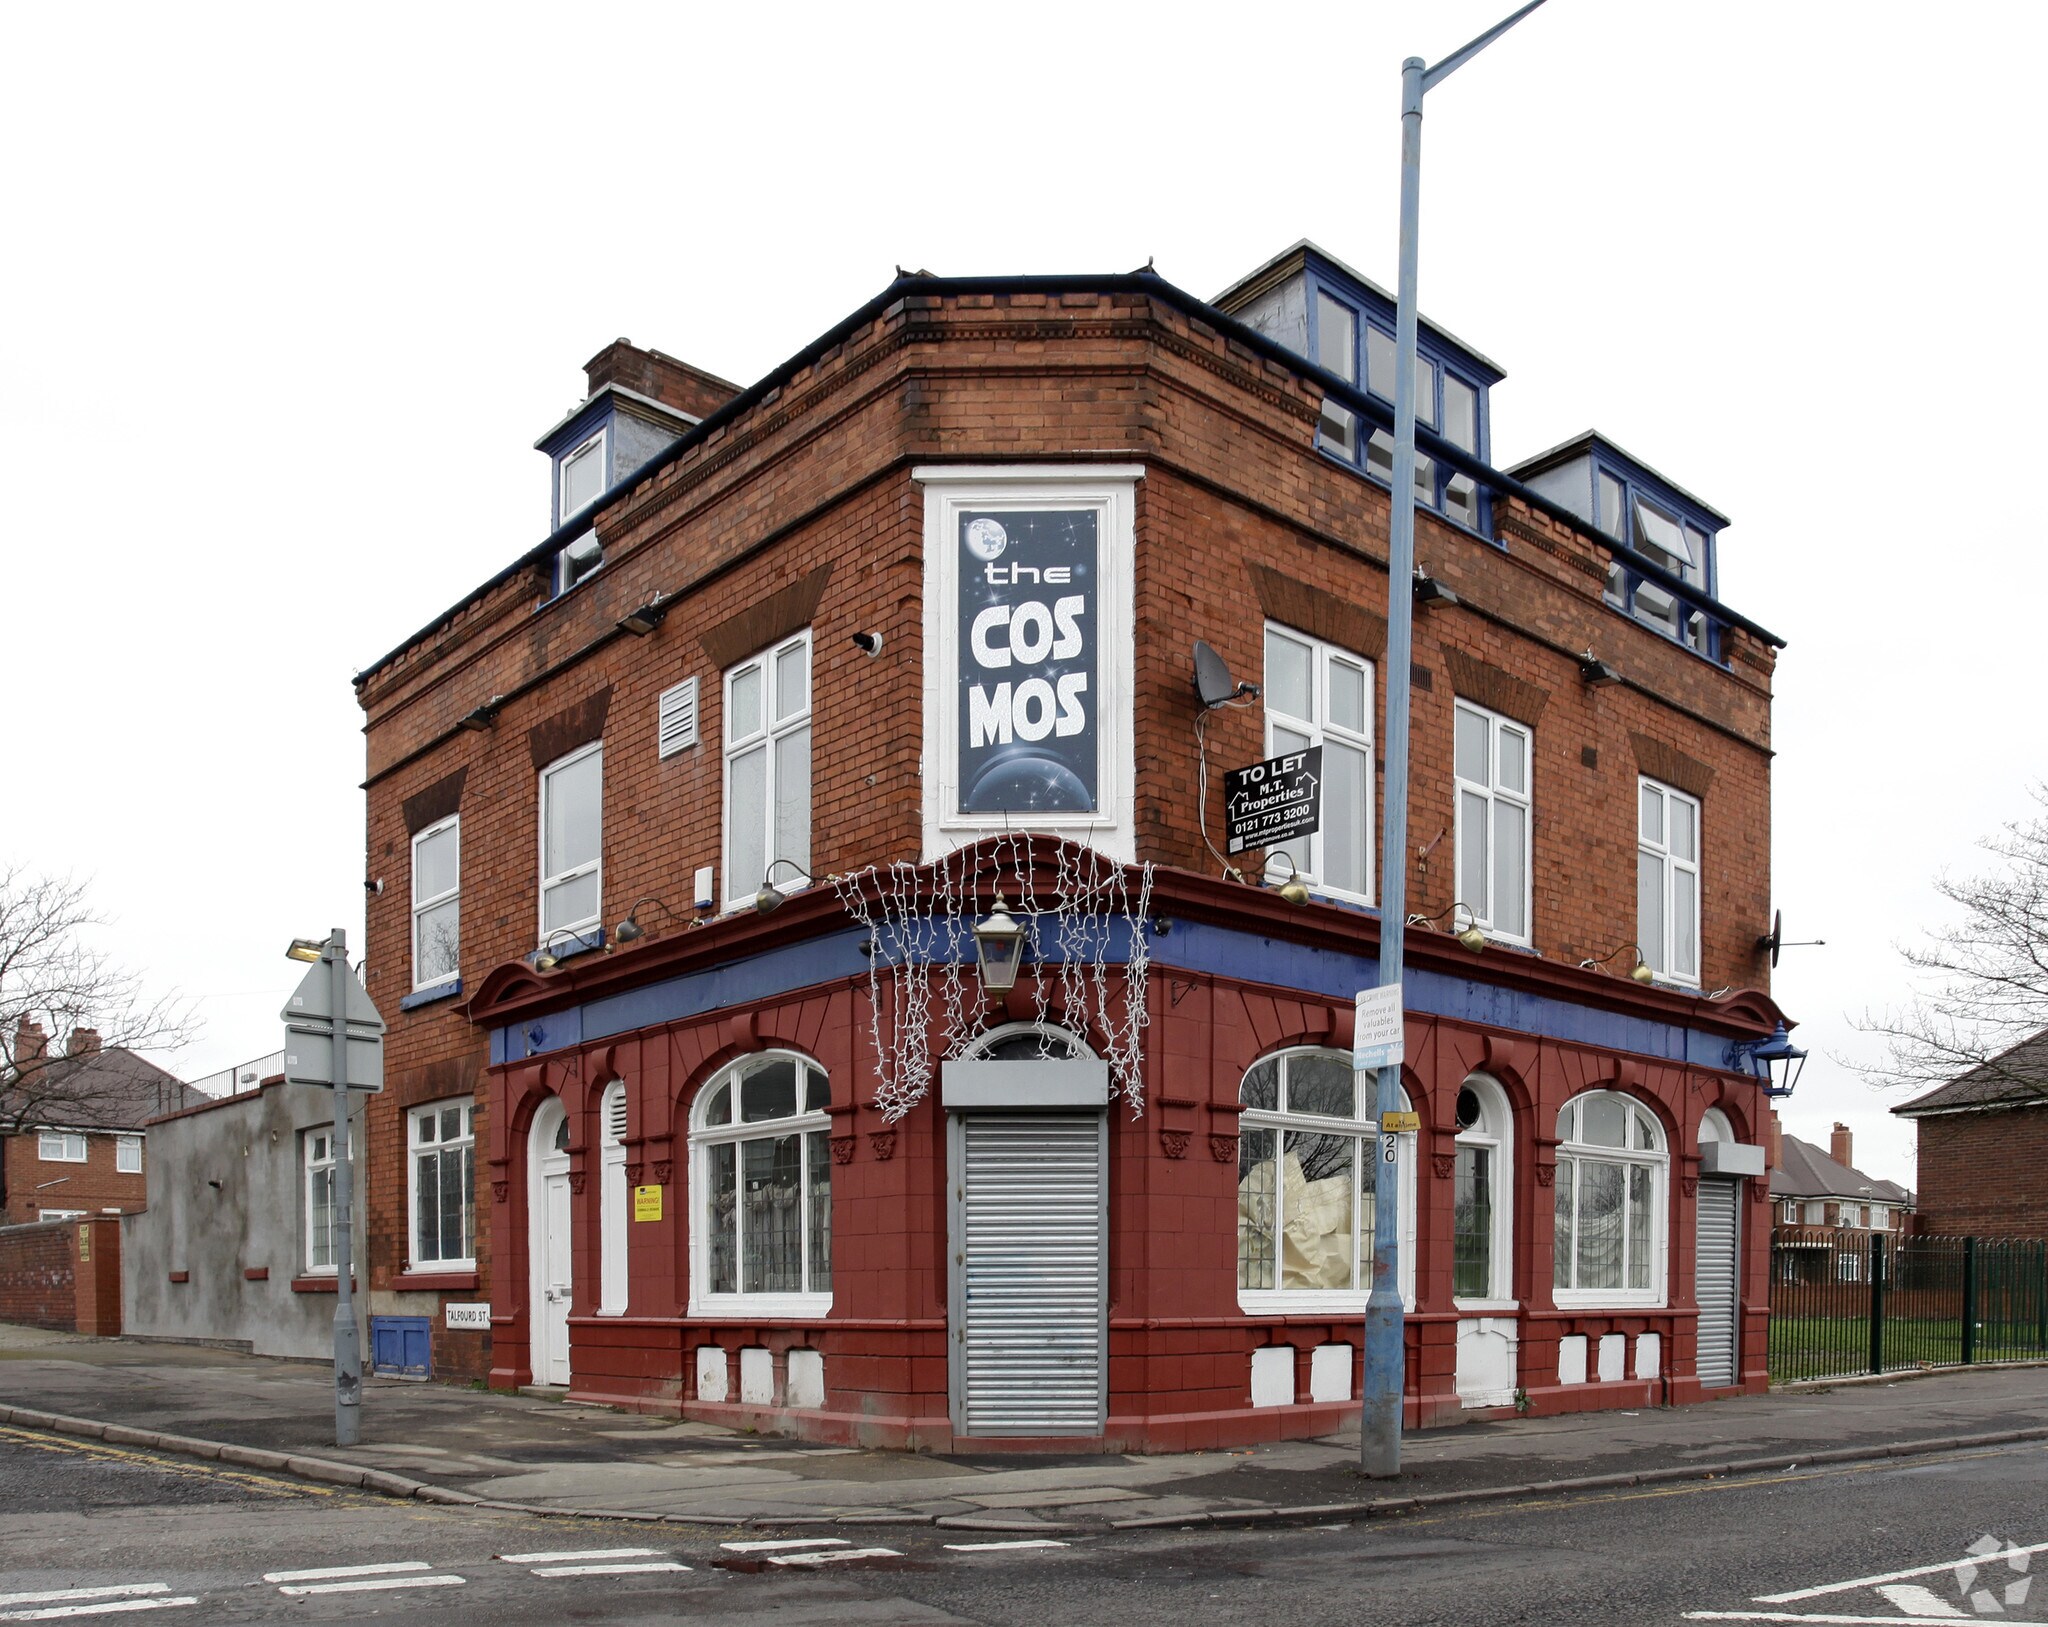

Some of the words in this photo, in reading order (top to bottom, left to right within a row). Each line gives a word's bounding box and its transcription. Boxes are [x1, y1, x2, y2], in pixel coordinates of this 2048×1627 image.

[984, 561, 1071, 585] the
[970, 594, 1085, 669] COS
[969, 672, 1088, 749] MOS
[1239, 766, 1265, 786] TO
[1271, 753, 1307, 777] LET
[1259, 779, 1284, 796] M.T.
[1240, 787, 1304, 813] Properties
[1235, 818, 1258, 834] 0121
[1262, 812, 1281, 827] 773
[1283, 804, 1310, 820] 3200
[1361, 1006, 1387, 1018] Remove
[1387, 1002, 1396, 1013] all
[1363, 1016, 1394, 1028] valuables
[1357, 1031, 1373, 1041] from
[1373, 1029, 1389, 1040] your
[1389, 1027, 1401, 1035] car
[447, 1310, 477, 1322] TALFOURD
